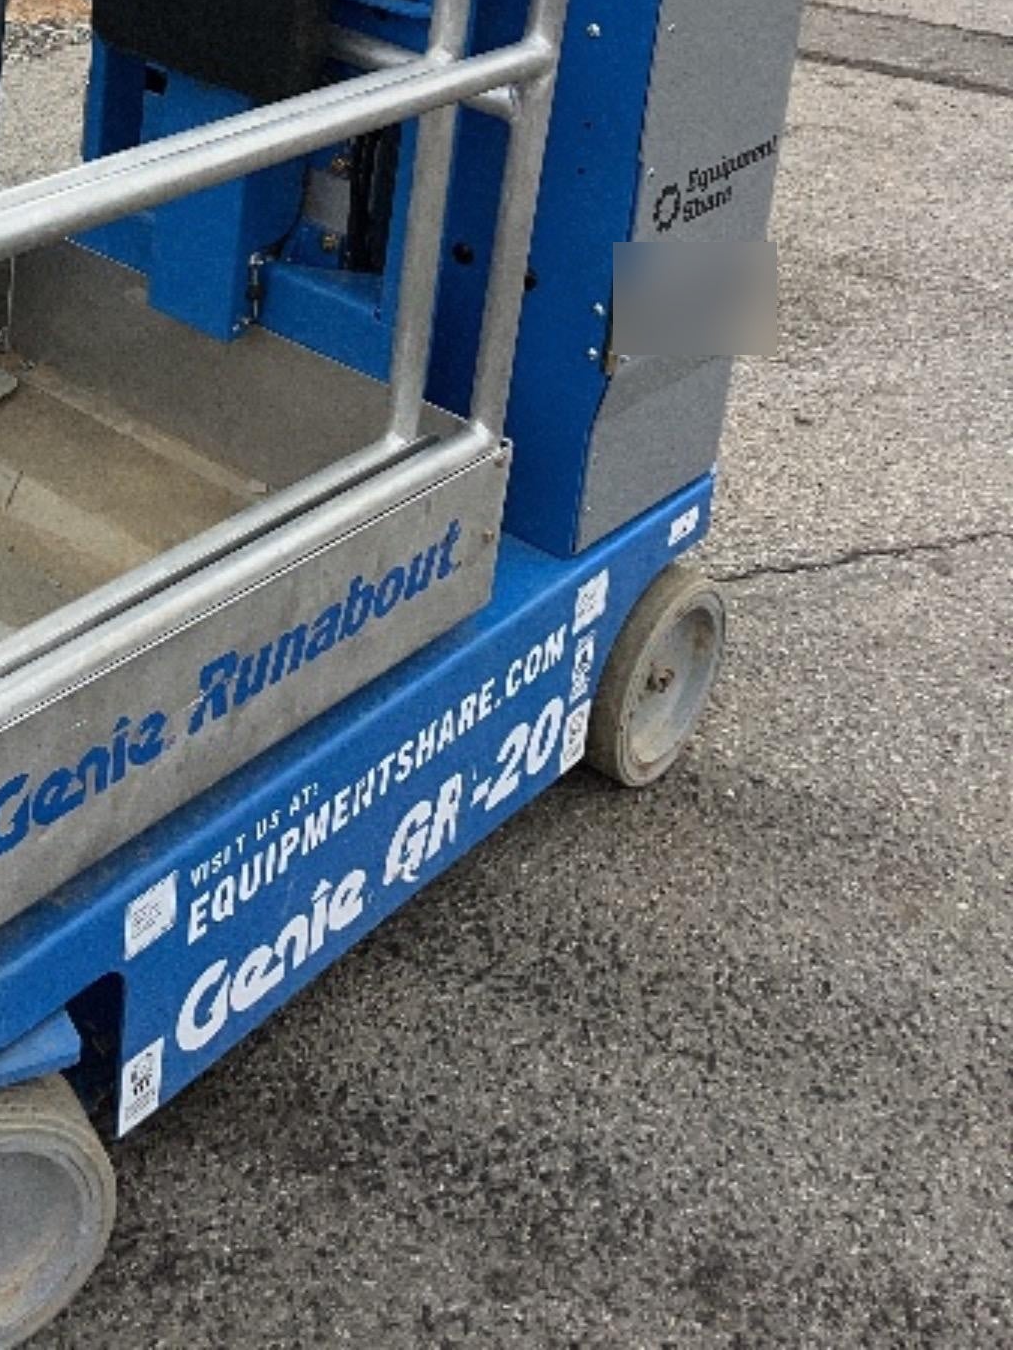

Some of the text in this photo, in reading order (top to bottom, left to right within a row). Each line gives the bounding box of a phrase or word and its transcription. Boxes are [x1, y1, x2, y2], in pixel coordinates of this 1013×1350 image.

[188, 518, 462, 736] Runabout
[187, 622, 568, 947] EQUIPMENTSHARE.COM
[190, 833, 246, 888] VISIT
[255, 809, 281, 841] US
[175, 868, 368, 1052] Genie
